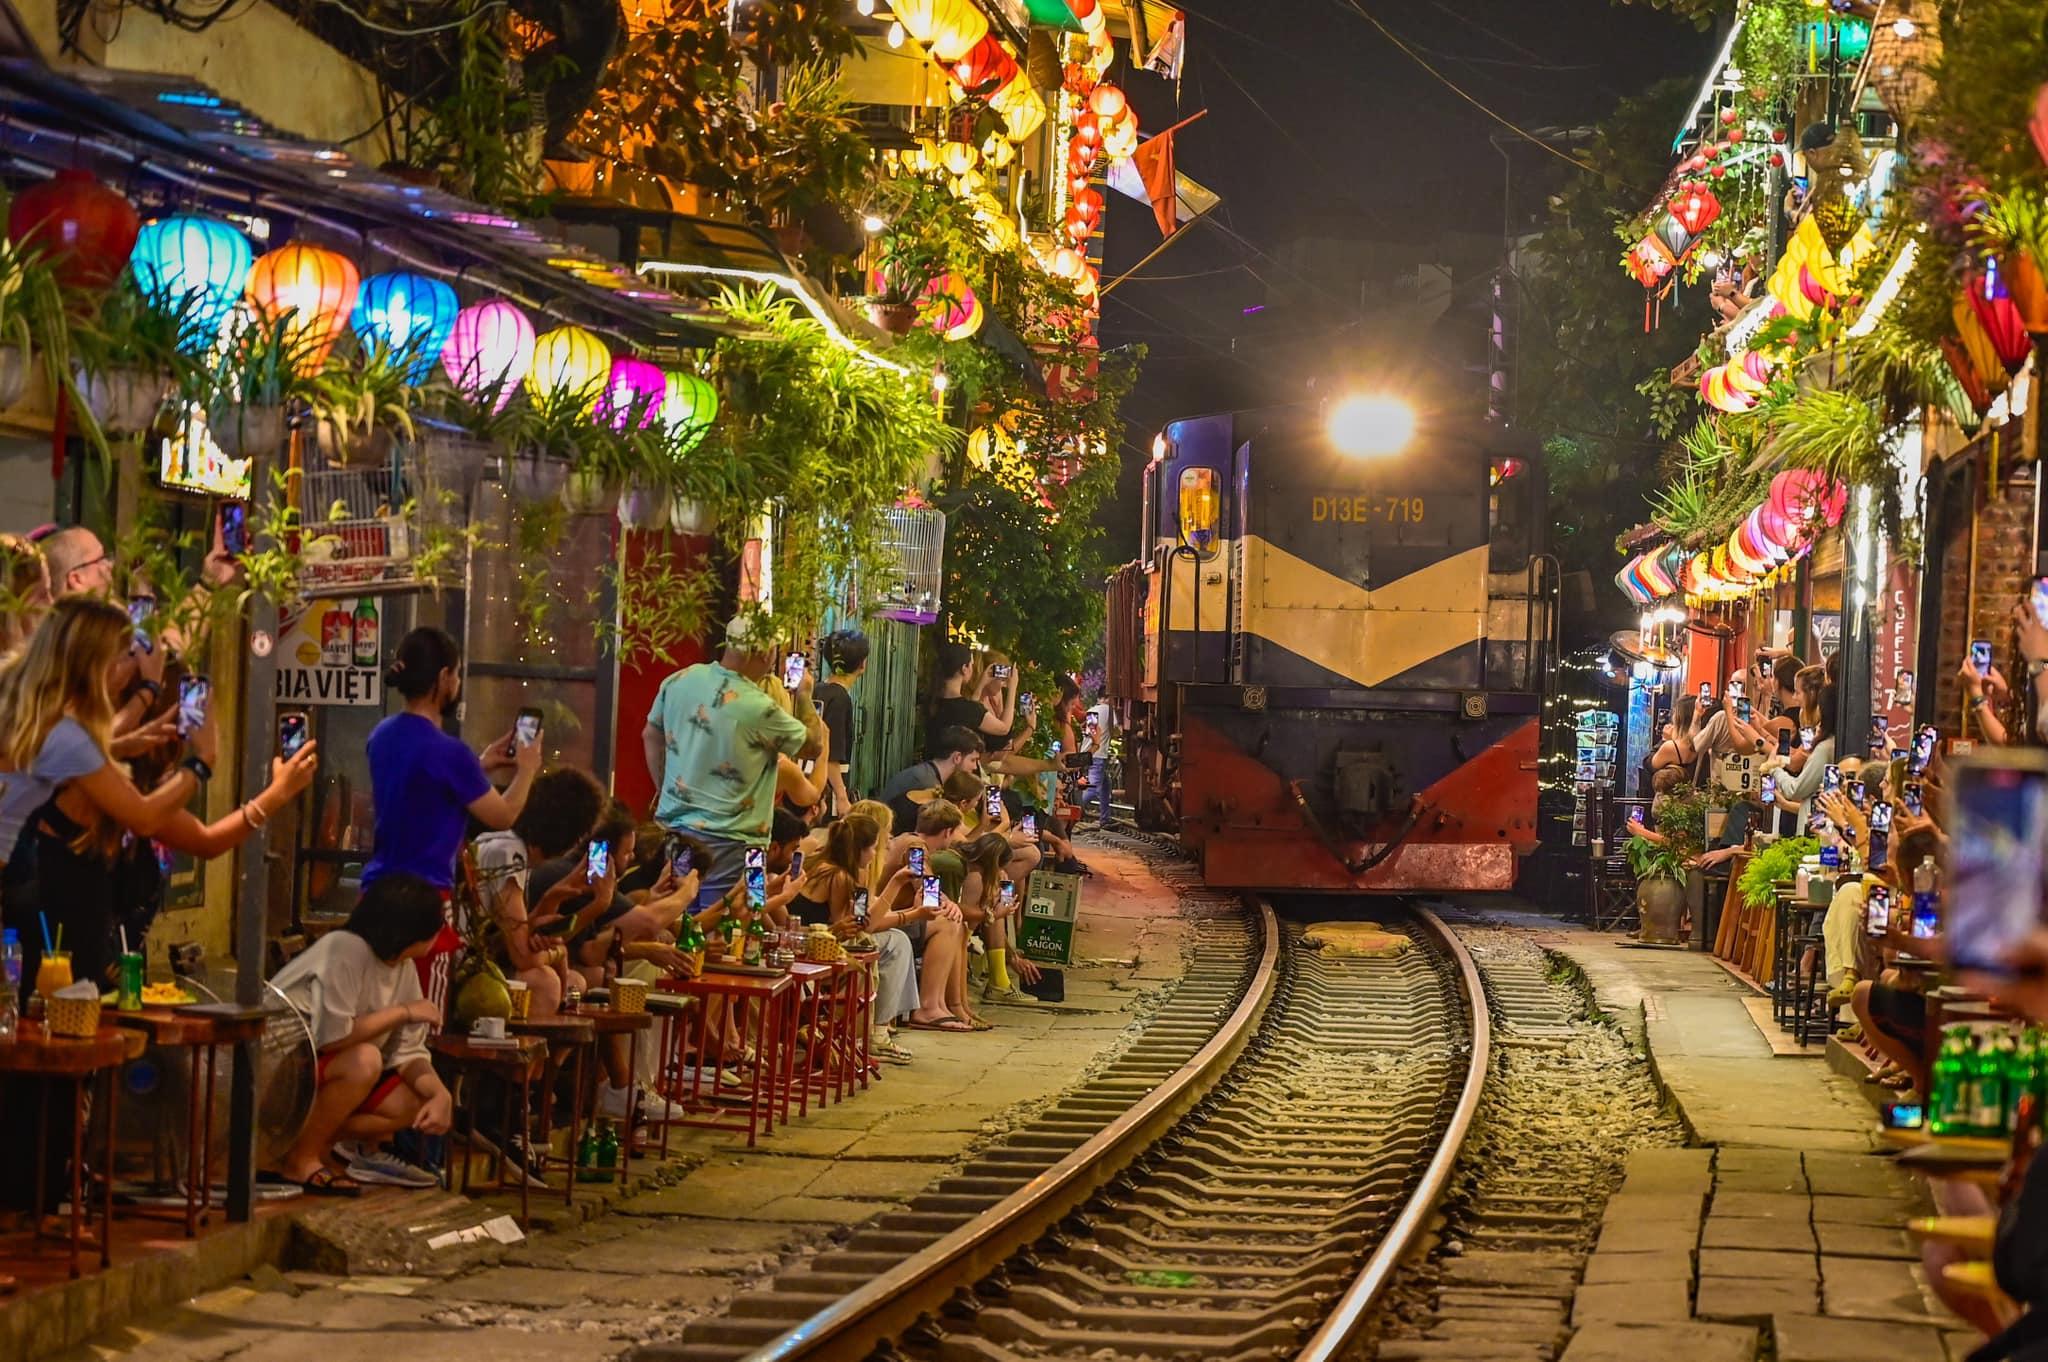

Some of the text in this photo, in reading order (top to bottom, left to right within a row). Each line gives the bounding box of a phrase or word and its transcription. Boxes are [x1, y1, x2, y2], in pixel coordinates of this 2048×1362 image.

[1312, 496, 1367, 522] D13E
[1385, 496, 1424, 522] 719
[315, 666, 377, 704] VIỆT
[1031, 903, 1049, 914] en
[1026, 939, 1063, 951] SAIGON
